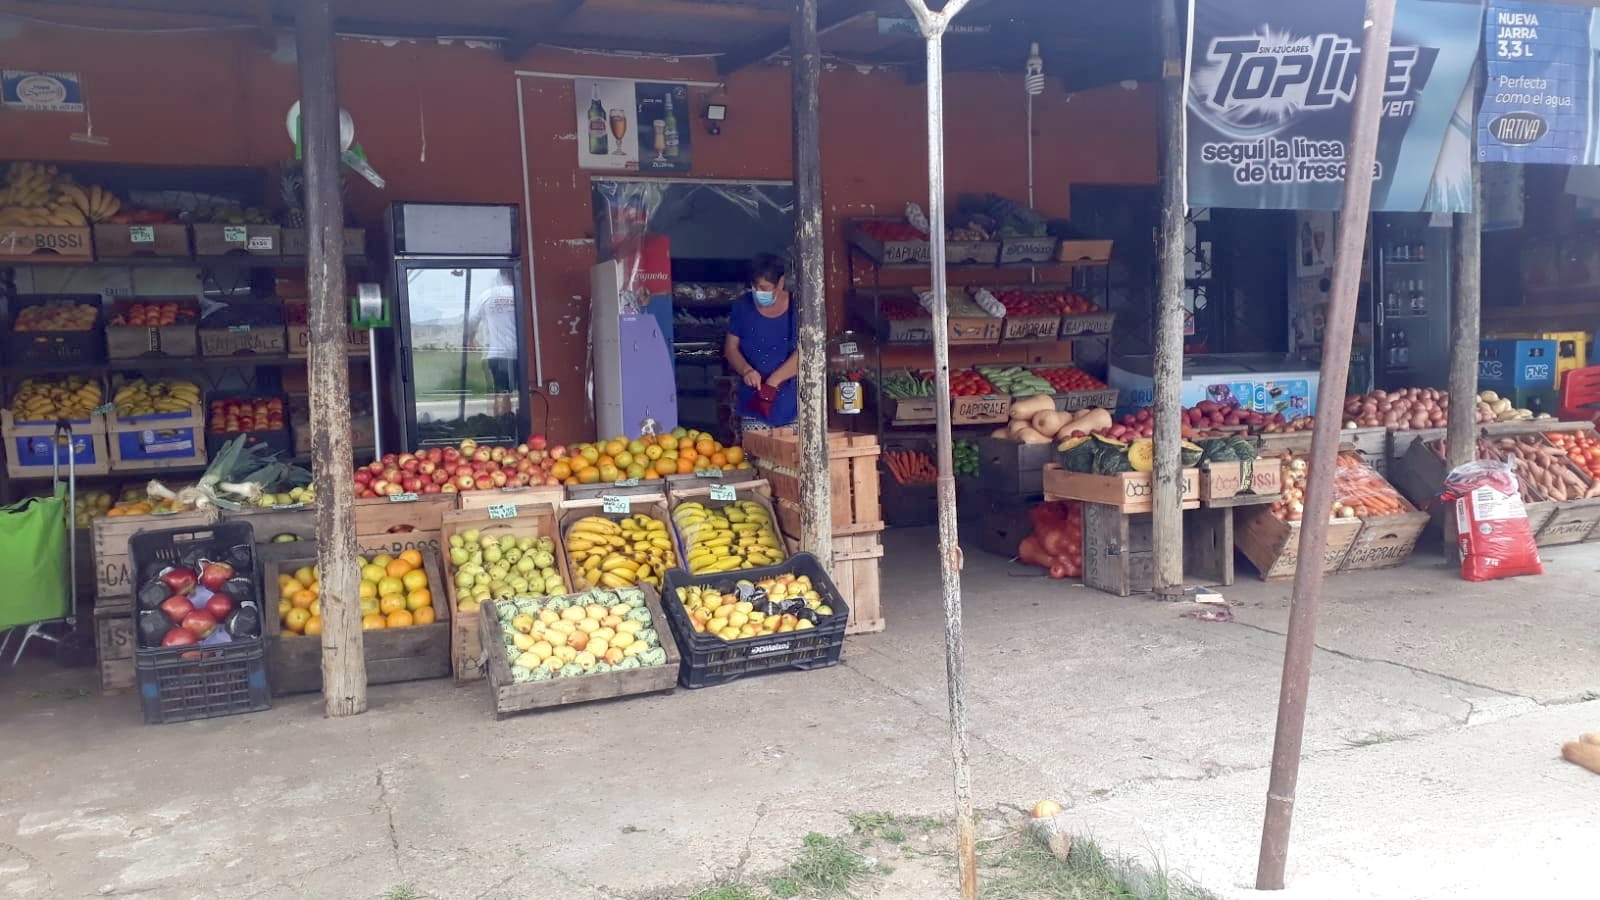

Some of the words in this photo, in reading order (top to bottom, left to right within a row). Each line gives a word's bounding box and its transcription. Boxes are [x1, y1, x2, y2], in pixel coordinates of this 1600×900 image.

[1498, 13, 1539, 26] NUEVA
[1497, 27, 1538, 39] JARRA
[1259, 46, 1271, 54] SIN
[1497, 40, 1522, 59] 3,3
[1525, 45, 1533, 56] L
[1500, 75, 1547, 90] Perfecta
[1495, 93, 1531, 104] como
[1533, 92, 1544, 104] el
[1545, 96, 1573, 107] agua.
[1497, 118, 1540, 140] NATIVA
[1203, 140, 1264, 163] seguí
[1270, 140, 1289, 159] la
[1294, 138, 1343, 158] línea
[1236, 163, 1264, 182] de
[1270, 163, 1292, 181] tu
[1298, 161, 1380, 180] fresca
[35, 233, 82, 248] BOSSI
[1010, 322, 1056, 337] CAPORALE
[1478, 361, 1502, 377] NC
[1525, 364, 1548, 380] FNC
[960, 402, 1006, 416] CAPORALE
[1069, 394, 1113, 409] CAPORALE
[392, 539, 438, 552] BOSS
[1351, 543, 1406, 564] CAPORALE
